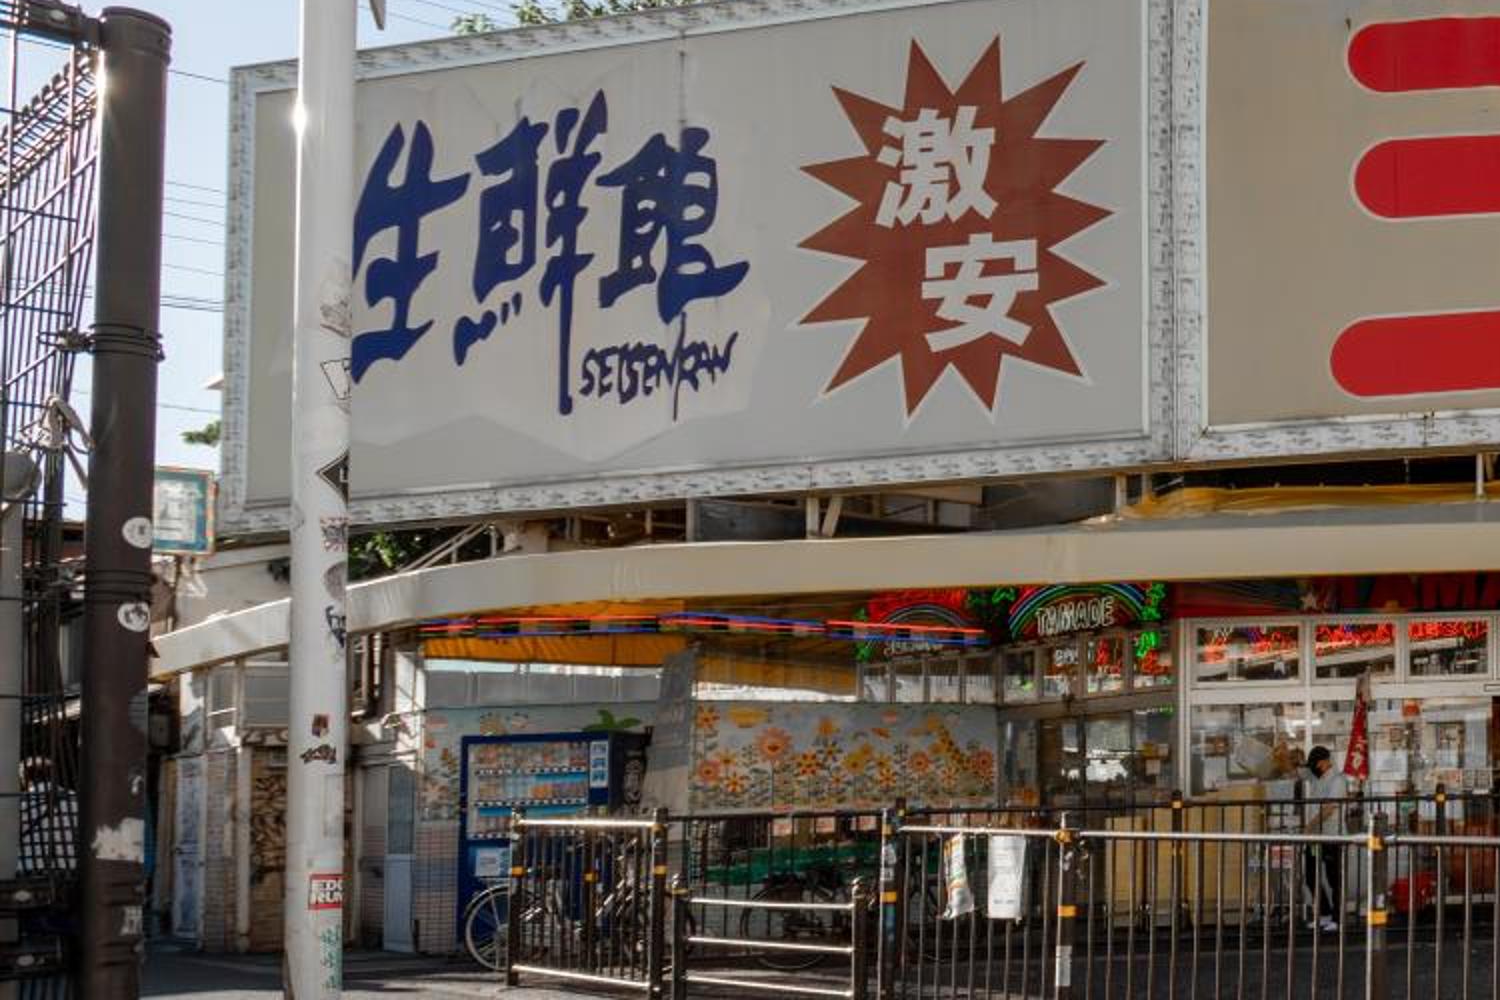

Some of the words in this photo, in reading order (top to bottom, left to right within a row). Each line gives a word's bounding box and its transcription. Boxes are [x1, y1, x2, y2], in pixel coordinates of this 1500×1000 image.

[351, 88, 751, 416] 生鮮館
[875, 104, 1039, 353] 激安
[579, 311, 739, 421] SEISENKAN
[1035, 595, 1115, 637] TAMADE
